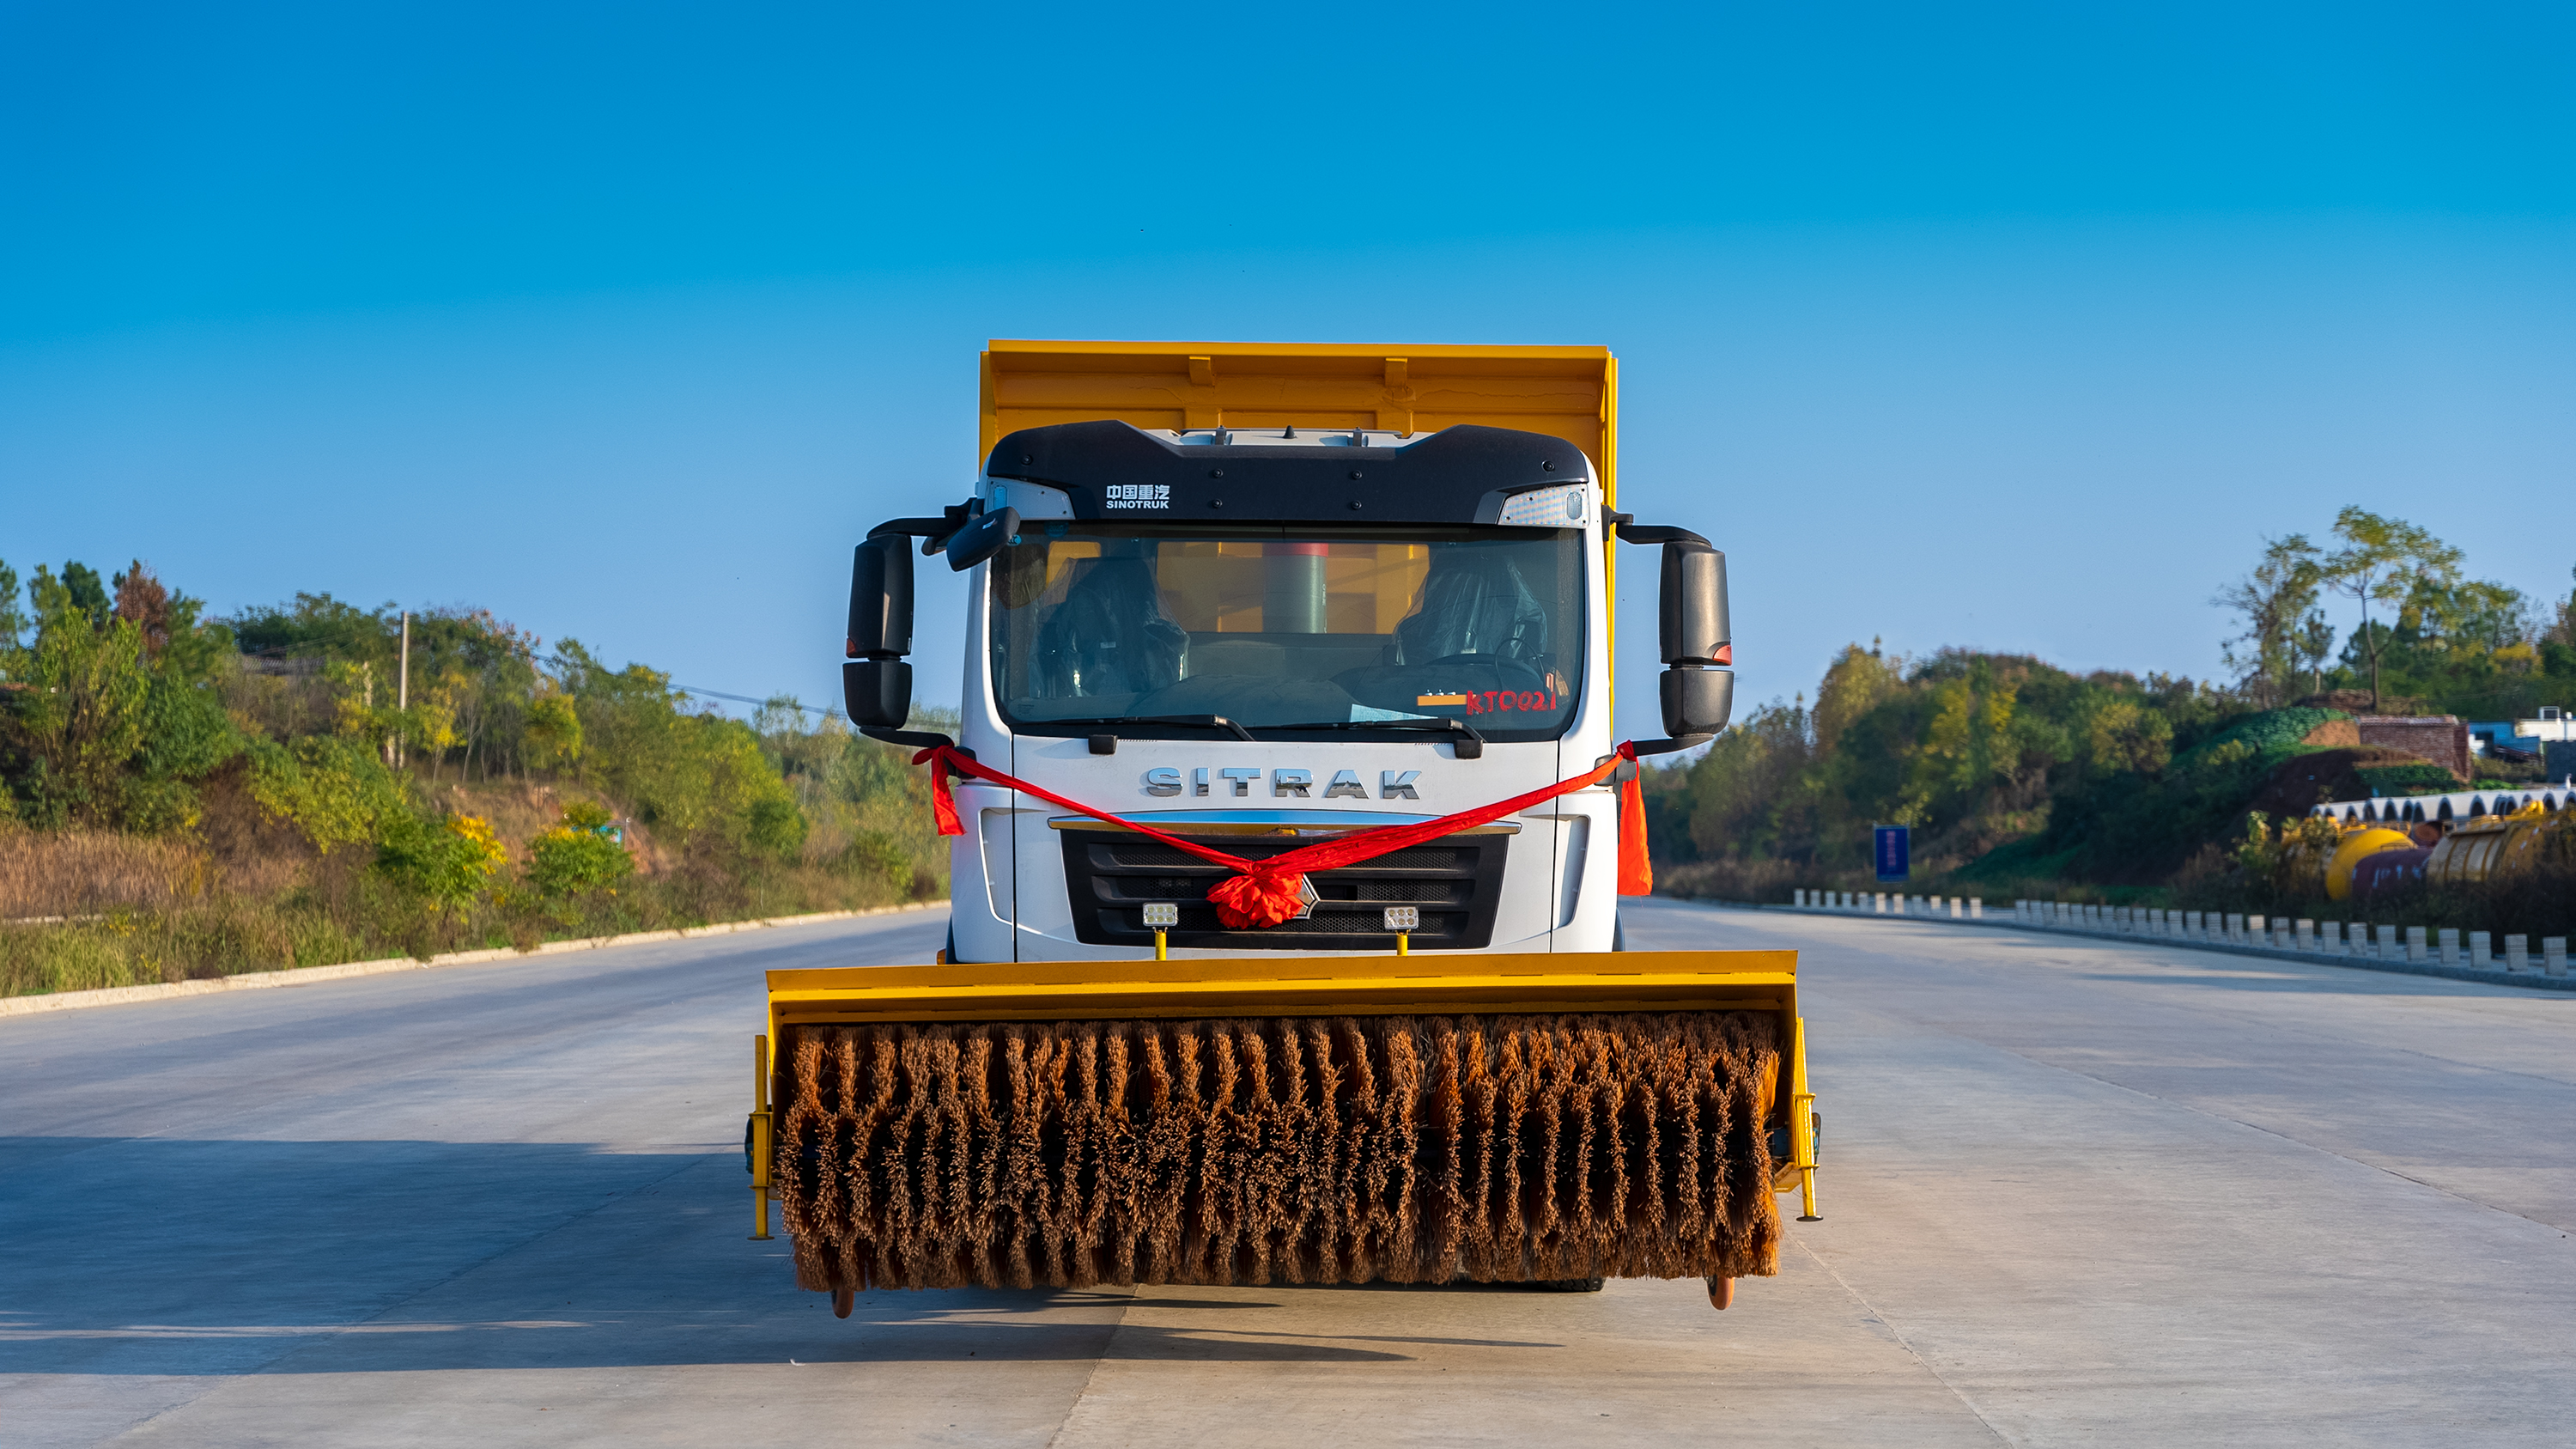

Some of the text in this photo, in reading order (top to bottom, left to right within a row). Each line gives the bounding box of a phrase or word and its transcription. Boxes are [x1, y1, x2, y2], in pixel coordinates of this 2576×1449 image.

[1106, 484, 1170, 499] 中国重汽
[1106, 500, 1169, 508] SINOTRUK
[1146, 767, 1422, 800] SITRAK
